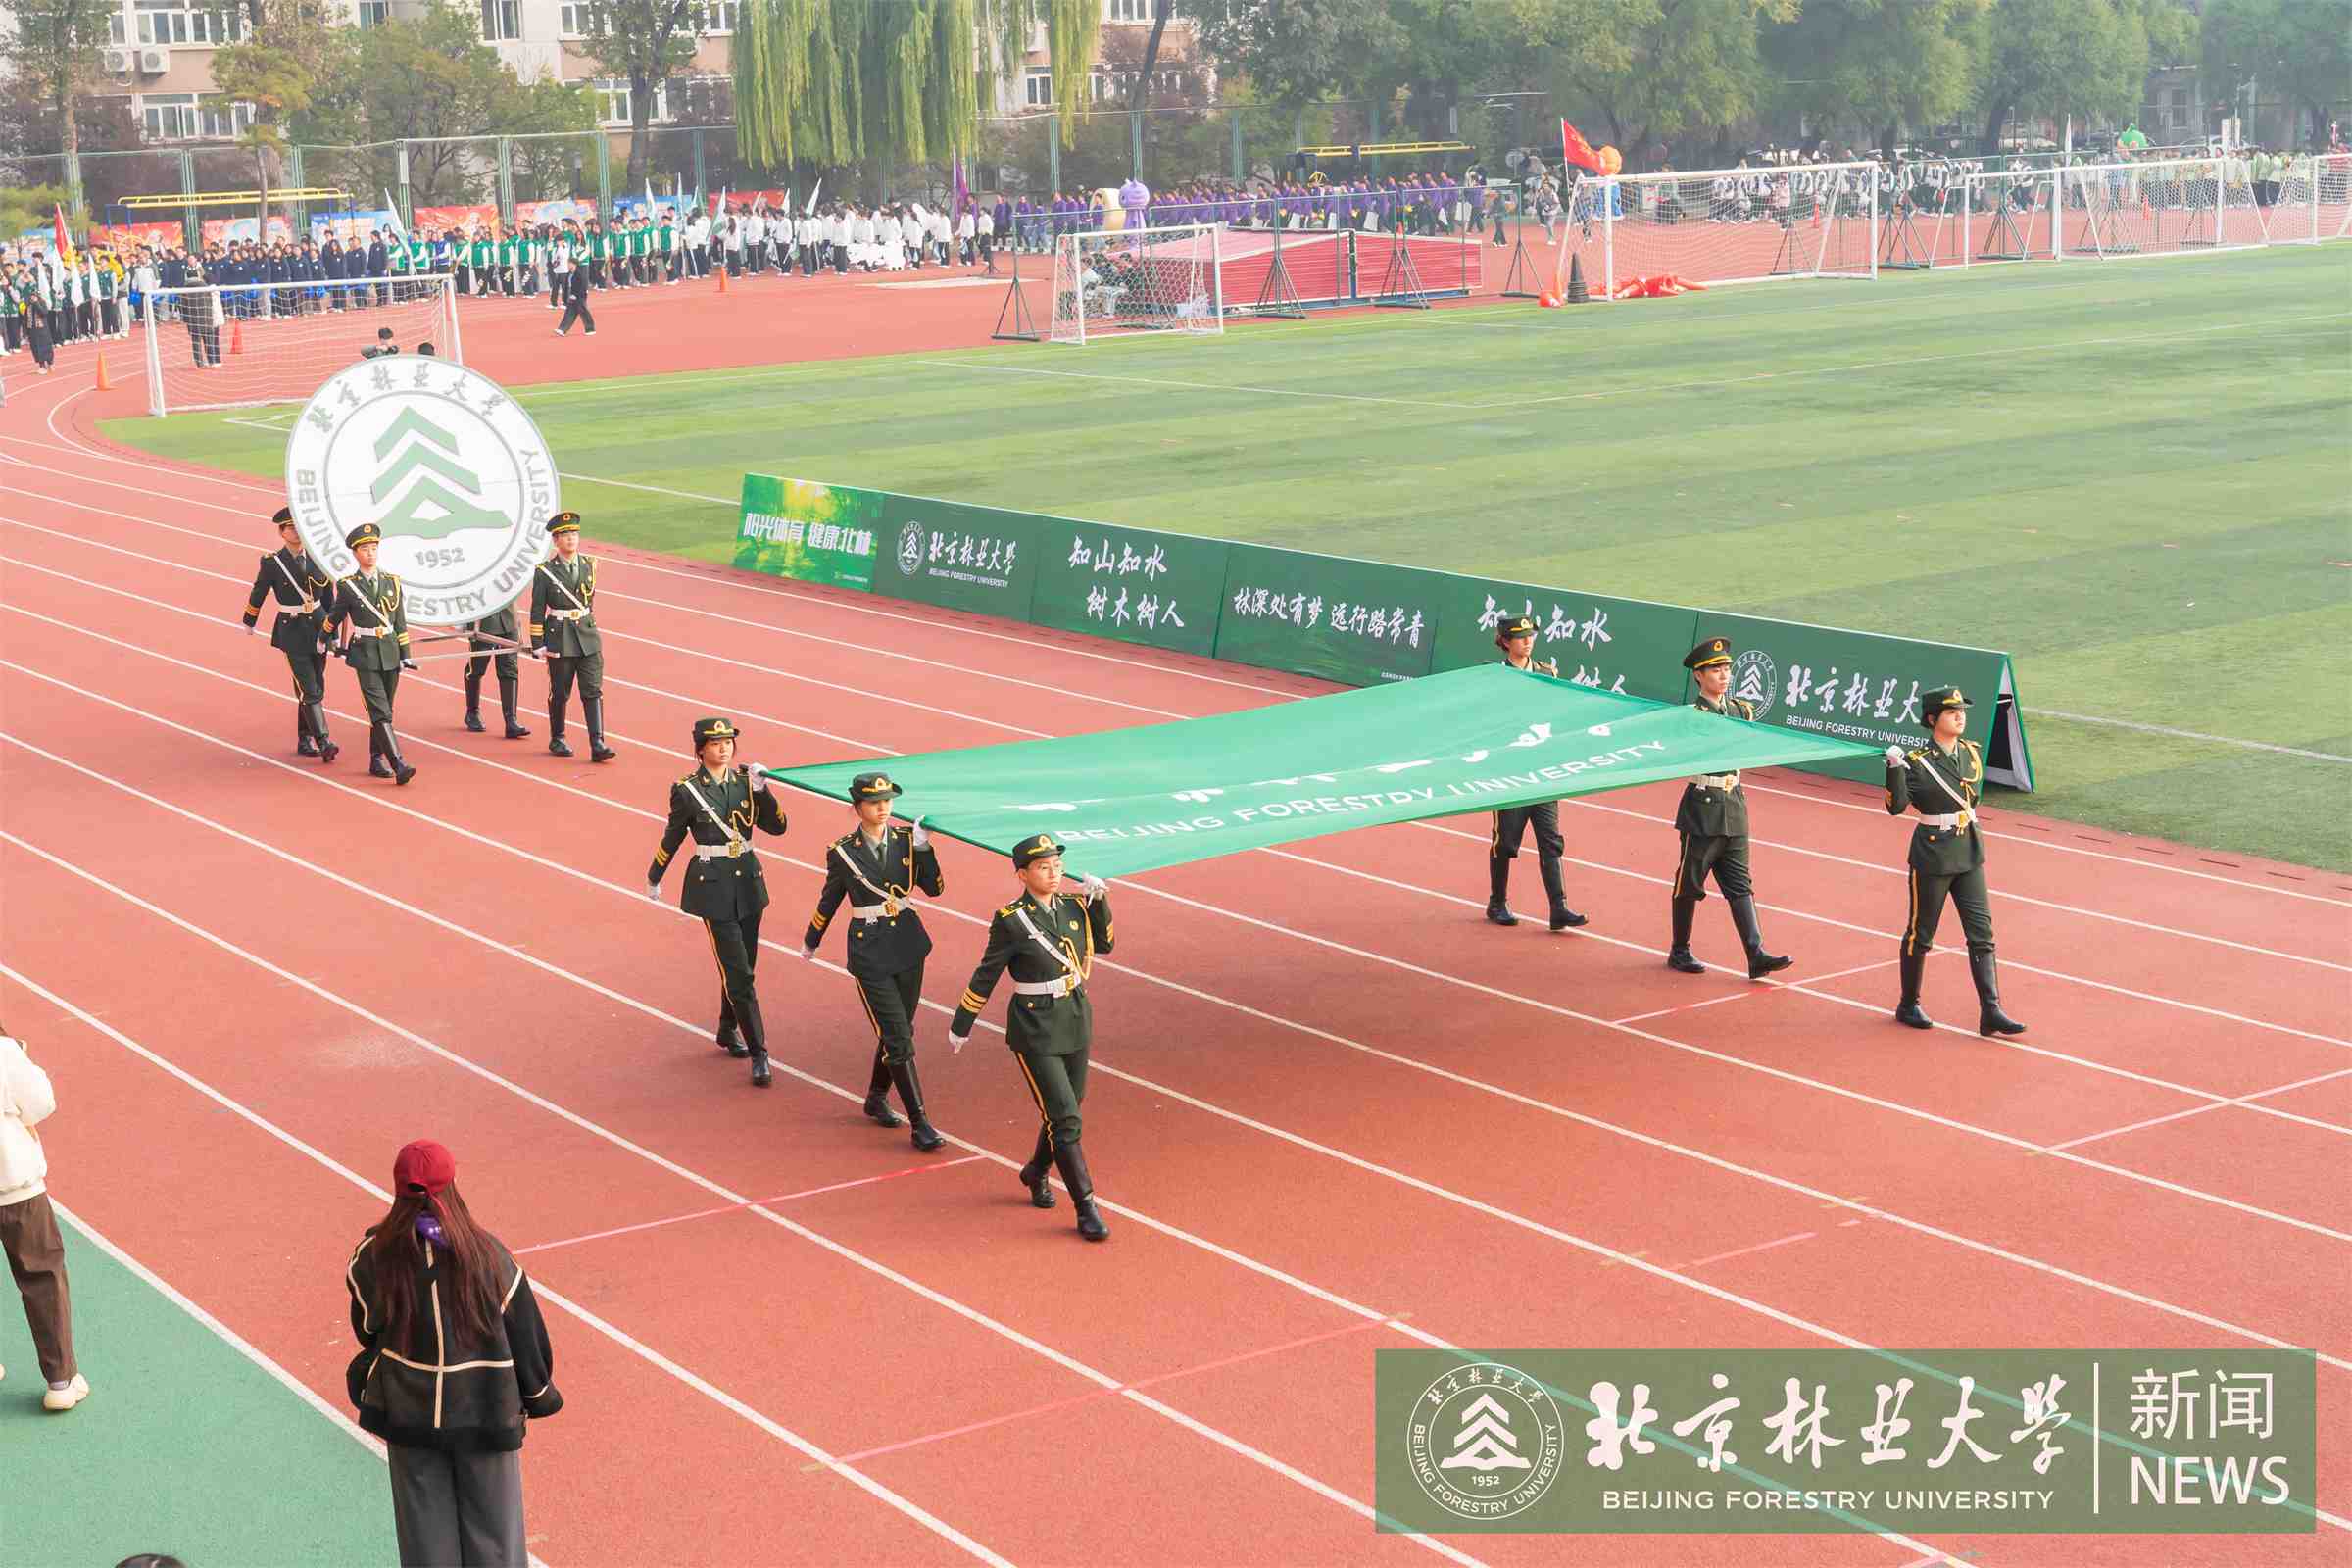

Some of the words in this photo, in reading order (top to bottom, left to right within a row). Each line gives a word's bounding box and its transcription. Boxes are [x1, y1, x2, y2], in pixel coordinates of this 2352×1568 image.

[403, 587, 487, 617] ESTRY
[493, 449, 550, 593] UNIVERSITY
[415, 547, 466, 568] 1952
[928, 567, 950, 578] BEIJING
[950, 571, 977, 583] FORESTRY
[977, 575, 1008, 588] UNIVERSITY
[1068, 535, 1167, 582] 知山知水
[1086, 585, 1185, 630] 树木树人
[1233, 587, 1324, 630] 林深处有梦
[1330, 603, 1425, 649] 远行路常青
[1785, 664, 1923, 724] 北京林业大
[1786, 715, 1823, 730] BEIJING
[1825, 721, 1876, 739] FORESTRY
[1447, 740, 1666, 796] UNIVERSITY
